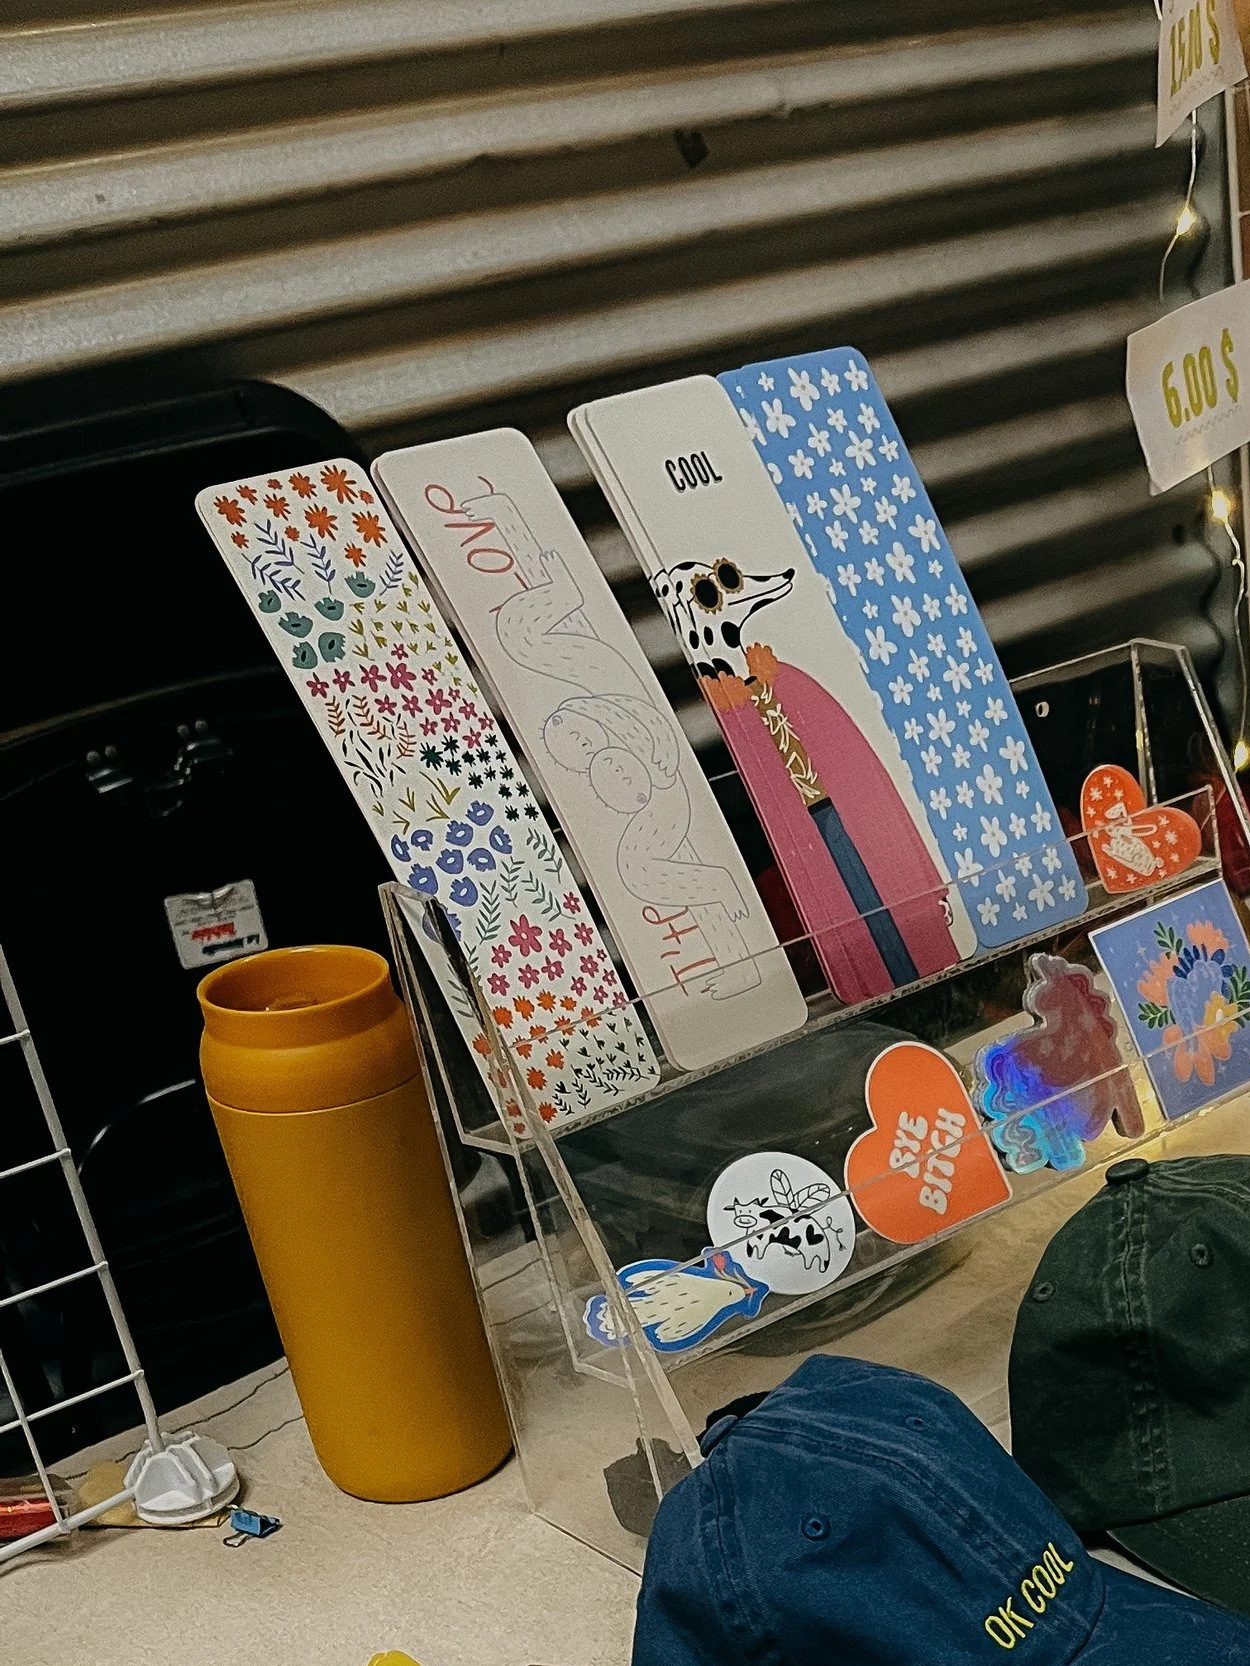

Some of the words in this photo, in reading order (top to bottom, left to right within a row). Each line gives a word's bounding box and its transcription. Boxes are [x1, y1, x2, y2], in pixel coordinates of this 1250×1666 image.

[1162, 345, 1218, 428] 6.00
[1221, 328, 1239, 403] $
[664, 451, 722, 493] COOL
[889, 1111, 928, 1179] BYE
[918, 1107, 967, 1215] BITCH
[984, 1596, 1035, 1649] OK
[1021, 1542, 1074, 1614] COOL
